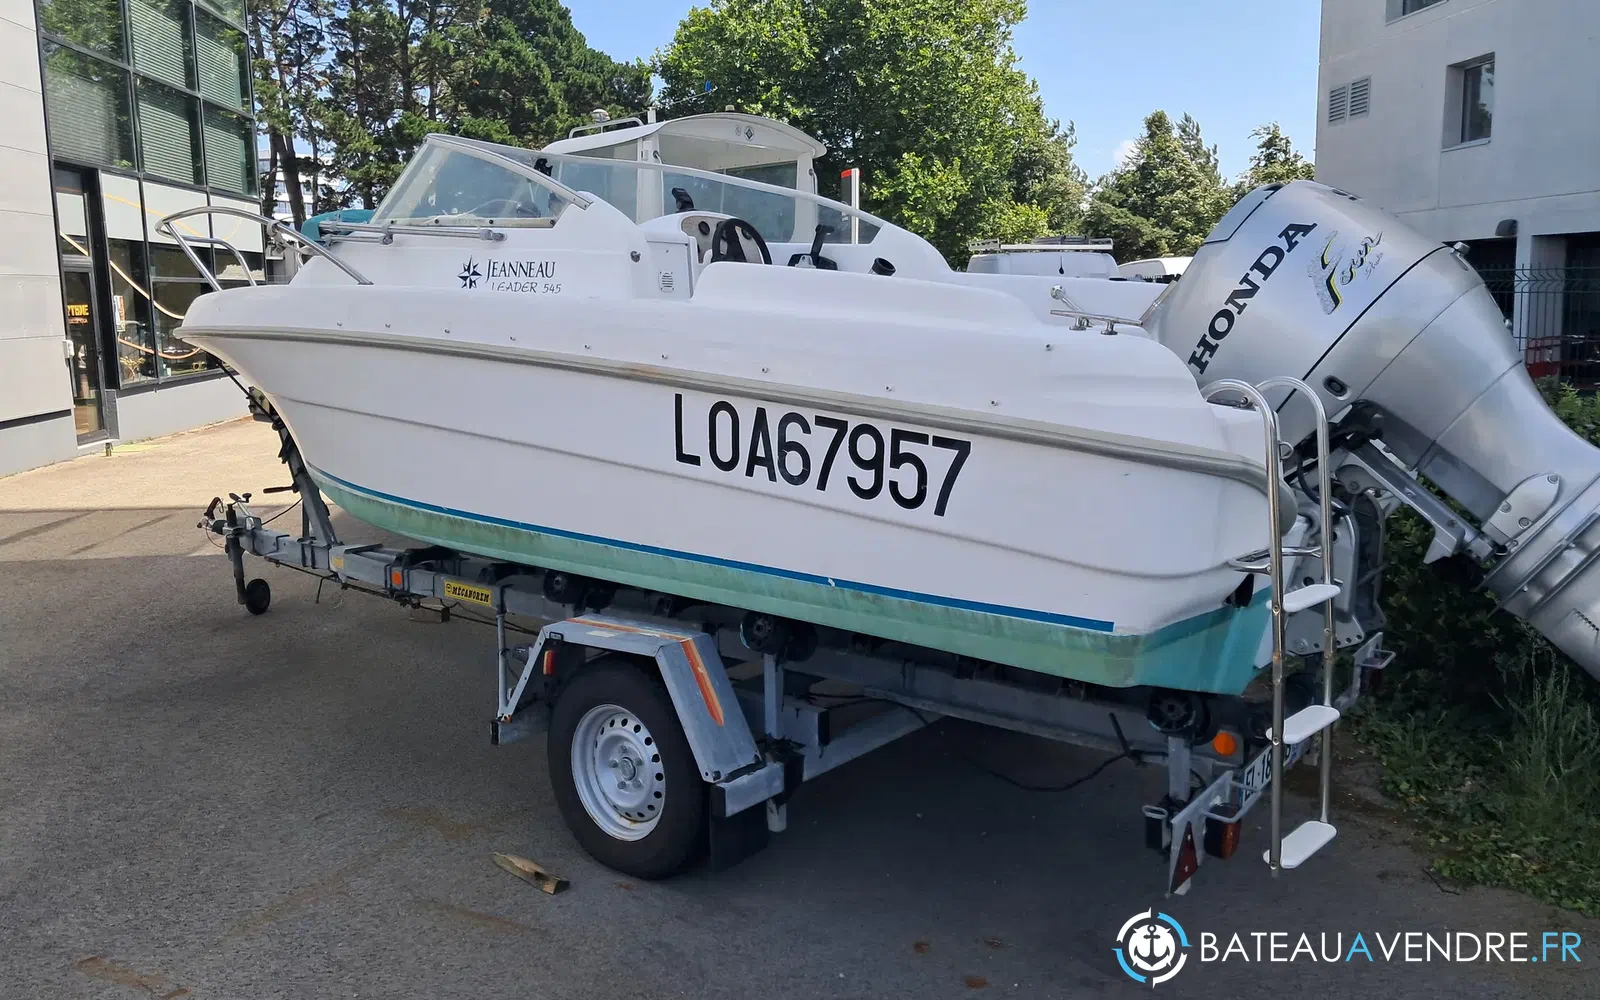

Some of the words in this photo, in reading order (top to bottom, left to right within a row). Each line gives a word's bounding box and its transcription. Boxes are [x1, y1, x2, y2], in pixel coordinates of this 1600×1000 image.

[485, 258, 556, 283] JEANNEAU
[542, 283, 562, 294] 545
[1187, 222, 1318, 375] HONDA
[674, 393, 972, 517] LOA67957
